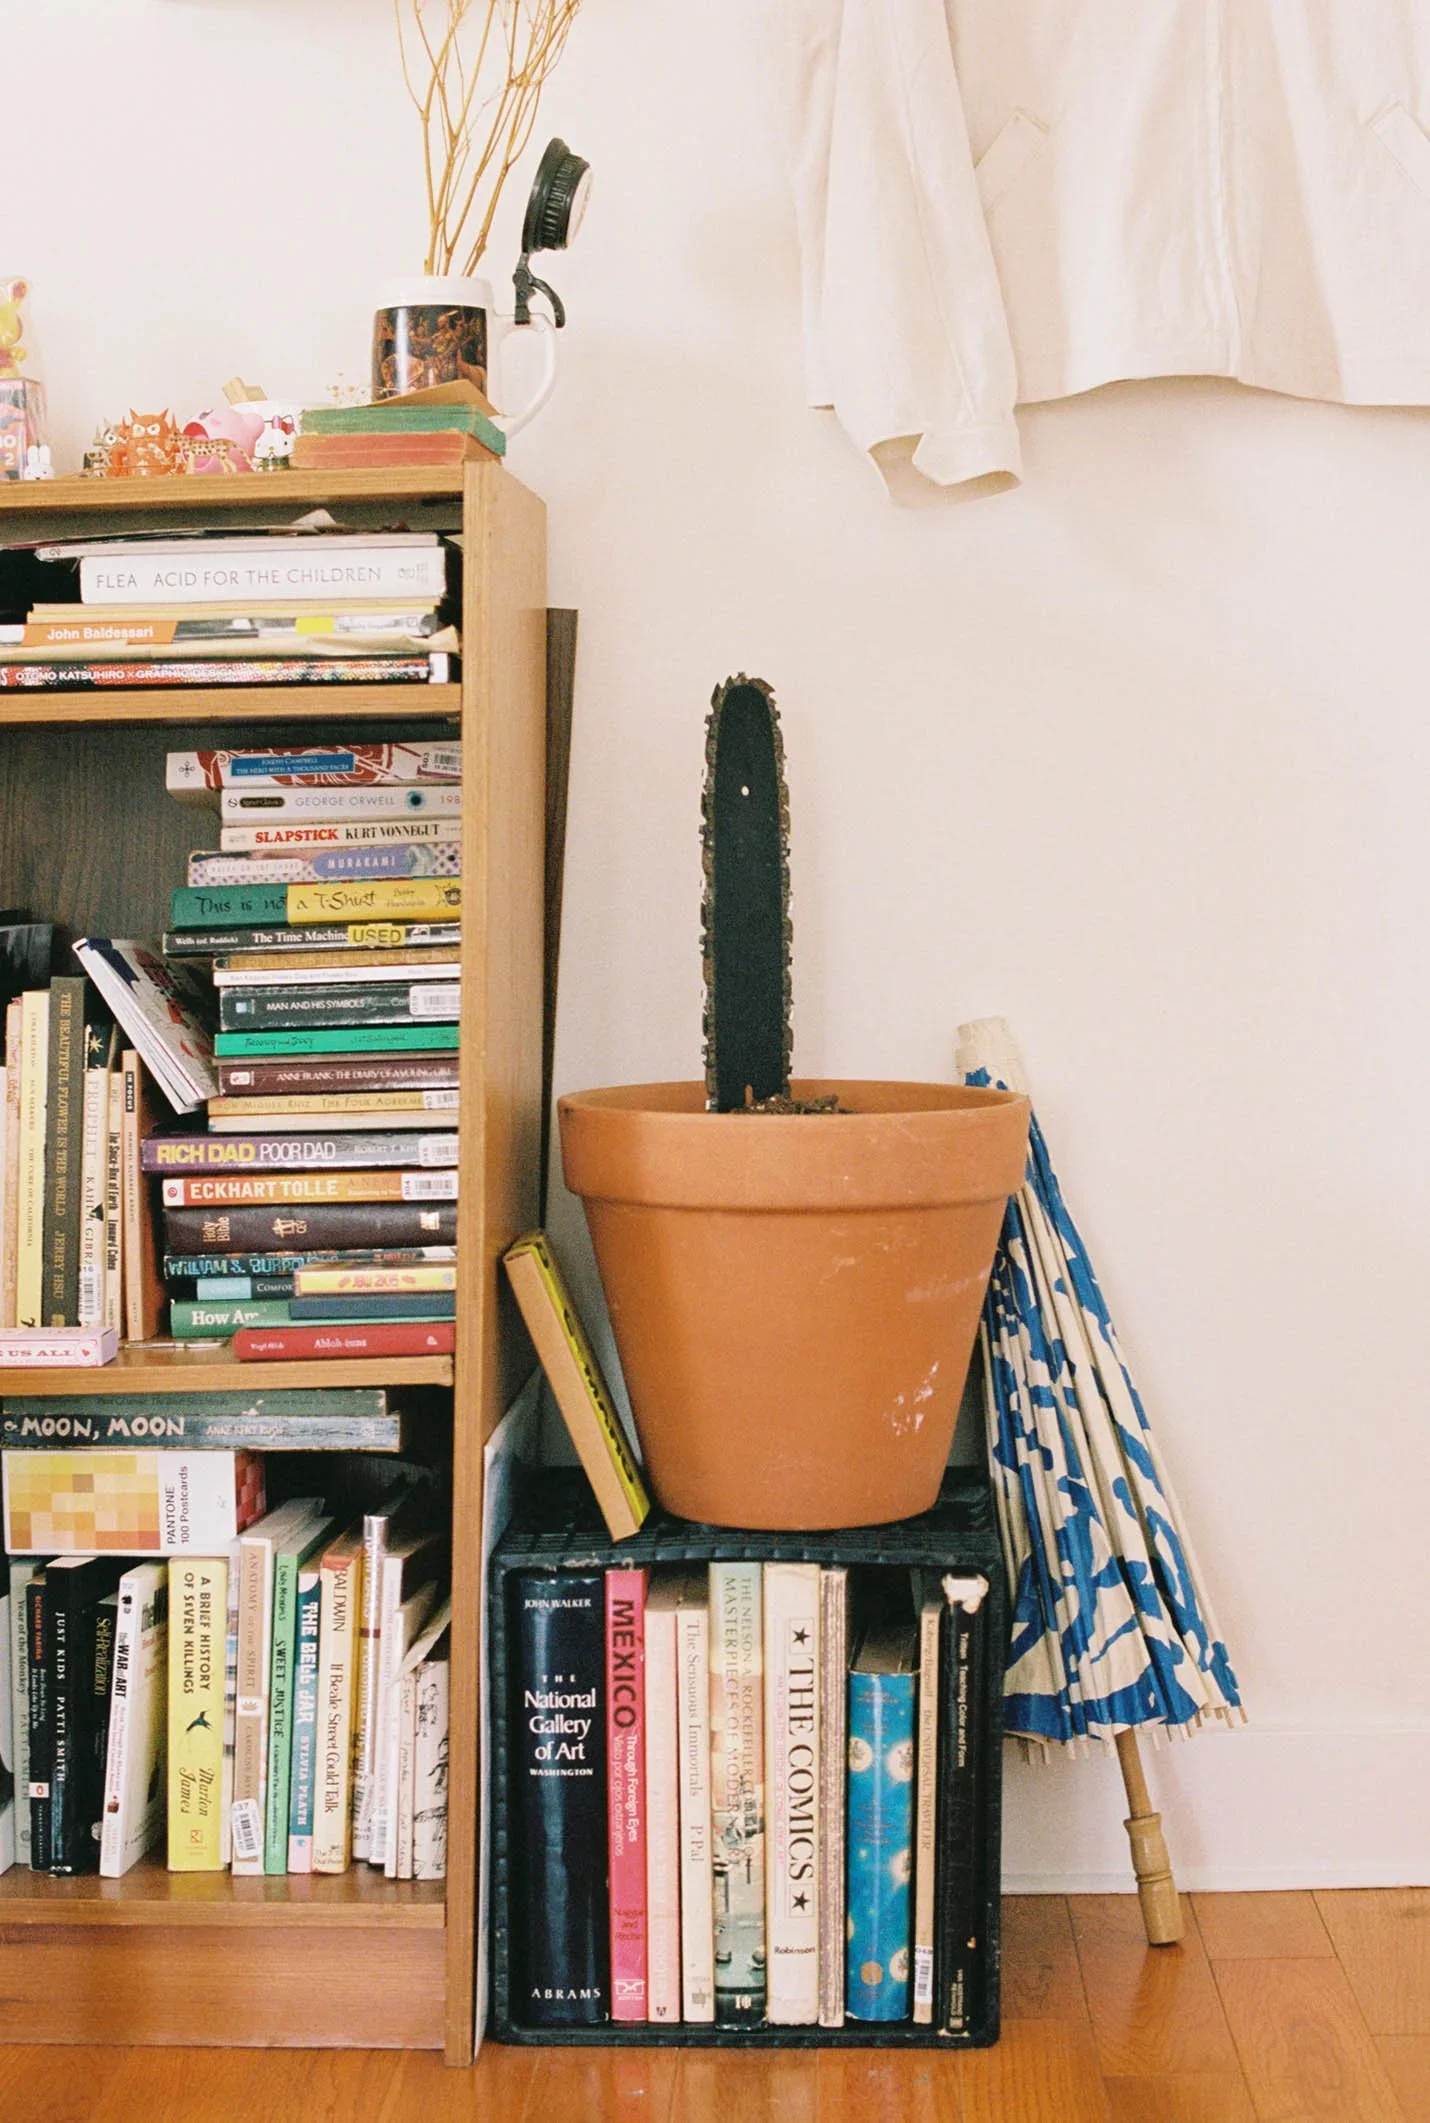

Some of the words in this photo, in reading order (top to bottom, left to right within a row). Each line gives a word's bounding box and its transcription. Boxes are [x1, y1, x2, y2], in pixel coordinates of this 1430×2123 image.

[96, 574, 138, 588] FLEA
[153, 572, 198, 587] ACID
[204, 570, 240, 586] FOR
[246, 569, 280, 584] THE
[287, 568, 382, 584] CHILDREN
[48, 628, 80, 640] John
[84, 626, 154, 640] Baldessari
[16, 670, 58, 680] OTOMO
[59, 670, 125, 680] KATSUHIRO
[135, 669, 188, 678] GRAPHIC
[295, 796, 347, 807] GEORGE
[350, 794, 395, 806] ORWELL
[256, 828, 338, 844] SLAPSTICK
[345, 826, 376, 840] KURT
[378, 824, 440, 838] VONNEGUT
[327, 855, 396, 869] MURAKAMI
[195, 896, 232, 916] This
[240, 902, 252, 911] is
[296, 900, 308, 910] a
[314, 890, 376, 910] T-Shirt
[252, 932, 273, 943] The
[274, 932, 303, 942] Time
[305, 930, 348, 942] Machine
[352, 928, 402, 944] USED
[60, 992, 72, 1016] THE
[266, 1002, 288, 1010] MAN
[290, 1000, 310, 1010] AND
[312, 1000, 326, 1009] HIS
[326, 998, 365, 1009] SYMBOLS
[58, 1020, 72, 1084] BEAUTIFUL
[128, 1073, 132, 1083] IN
[276, 1073, 300, 1081] ANNE
[336, 1070, 352, 1080] THE
[352, 1069, 378, 1079] DIARY
[380, 1069, 391, 1078] OF
[57, 1086, 70, 1134] FLOWER
[86, 1081, 99, 1159] PROPHET
[56, 1136, 68, 1148] IS
[109, 1132, 120, 1144] The
[56, 1150, 68, 1174] THE
[109, 1146, 120, 1180] Spice-Box
[157, 1144, 204, 1165] RICH
[208, 1143, 256, 1164] DAD
[260, 1142, 302, 1162] POOR
[304, 1142, 336, 1161] DAD
[54, 1176, 66, 1216] WORLD
[109, 1182, 120, 1190] of
[190, 1182, 278, 1200] ECKHART
[280, 1180, 338, 1197] TOLLE
[108, 1192, 119, 1210] Earth
[108, 1220, 119, 1248] Leonard
[202, 1221, 216, 1242] Holy
[216, 1216, 230, 1242] Bible
[54, 1231, 66, 1272] JERRY
[108, 1250, 118, 1270] Cohen
[168, 1260, 228, 1276] WILLIAM
[230, 1259, 246, 1274] S.
[53, 1274, 64, 1300] HSU
[256, 1283, 294, 1292] COMFOR
[192, 1310, 230, 1326] How
[20, 1416, 100, 1441] MOON,
[107, 1416, 185, 1437] MOON
[179, 1466, 189, 1522] Postcards
[165, 1482, 176, 1544] PANTONE
[180, 1525, 190, 1544] 100
[184, 1572, 194, 1589] OF
[200, 1576, 212, 1586] A
[247, 1552, 258, 1612] ANATOMY
[742, 1576, 752, 1600] THE
[200, 1592, 211, 1630] BRIEF
[333, 1568, 348, 1632] BALDWIN
[524, 1599, 550, 1610] JOHN
[551, 1598, 591, 1608] WALKER
[56, 1612, 66, 1642] JUST
[184, 1594, 194, 1634] SEVEN
[301, 1602, 318, 1636] THE
[18, 1624, 26, 1634] of
[686, 1620, 700, 1650] The
[742, 1606, 752, 1662] NELSON
[18, 1636, 26, 1653] the
[726, 1576, 738, 1709] MASTERPIECES
[56, 1650, 66, 1680] KIDS
[94, 1617, 112, 1696] Self-Realization
[117, 1644, 130, 1670] WAR
[184, 1640, 194, 1694] KILLINGS
[200, 1634, 211, 1691] HISTORY
[246, 1650, 256, 1688] SPIRIT
[275, 1639, 286, 1682] SWEET
[300, 1642, 318, 1684] BELL
[16, 1656, 27, 1696] Monkey
[115, 1677, 127, 1698] ART
[542, 1674, 576, 1683] THE
[686, 1654, 700, 1718] Sensuous
[958, 1664, 969, 1703] Teaching
[328, 1674, 343, 1710] Beale
[524, 1688, 596, 1708] National
[788, 1658, 814, 1736] THE
[56, 1696, 66, 1734] PATTI
[273, 1688, 285, 1738] JUSTICE
[296, 1690, 315, 1724] JAR
[958, 1704, 968, 1727] Color
[20, 1714, 30, 1752] PATTI
[327, 1713, 342, 1750] Street
[529, 1716, 592, 1740] Gallery
[727, 1716, 738, 1737] OF
[743, 1685, 754, 1776] ROCKEFELLER
[958, 1728, 967, 1744] and
[299, 1735, 310, 1780] SYLVIA
[534, 1744, 554, 1760] of
[556, 1744, 586, 1760] Art
[614, 1734, 624, 1760] Visto
[624, 1734, 638, 1776] Through
[958, 1745, 967, 1768] Form
[56, 1740, 66, 1782] SMITH
[326, 1752, 341, 1785] Could
[530, 1768, 593, 1776] WASHINGTON
[612, 1762, 622, 1778] por
[688, 1724, 704, 1797] Immortals
[179, 1767, 197, 1814] James
[199, 1768, 216, 1816] Marlon
[324, 1788, 340, 1814] Talk
[612, 1780, 624, 1800] ojos
[624, 1778, 638, 1816] Foreign
[297, 1784, 308, 1825] PLATH
[788, 1744, 814, 1881] COMICS
[612, 1803, 624, 1856] extranjeros
[626, 1818, 640, 1842] Eyes
[922, 1791, 932, 1850] TRAVELER
[690, 1840, 704, 1862] Pal
[774, 1946, 816, 1955] Robinson
[532, 1988, 600, 2000] ABRAMS
